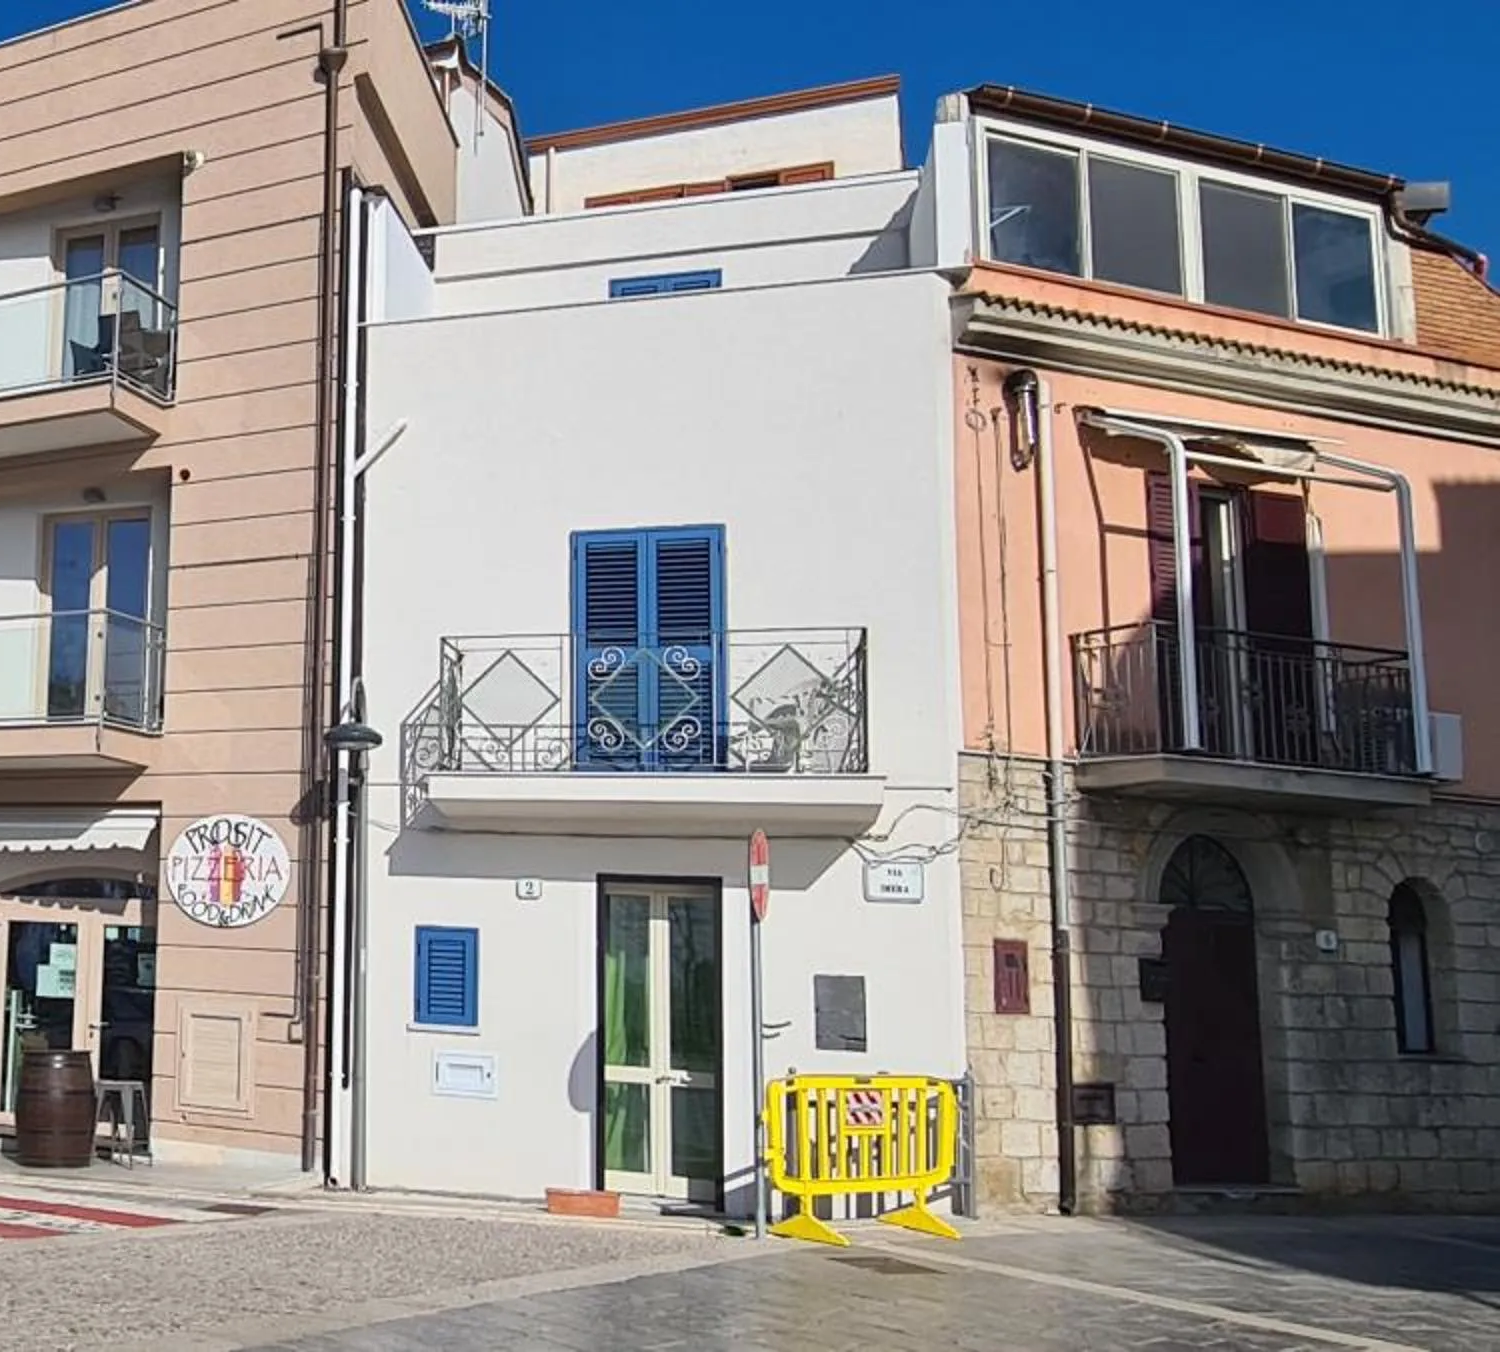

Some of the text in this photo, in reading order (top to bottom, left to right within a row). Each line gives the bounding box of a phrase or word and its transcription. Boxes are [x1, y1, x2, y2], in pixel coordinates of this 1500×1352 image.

[186, 818, 273, 854] PROSIT
[171, 855, 283, 881] PIZZERIA
[524, 880, 535, 896] 2
